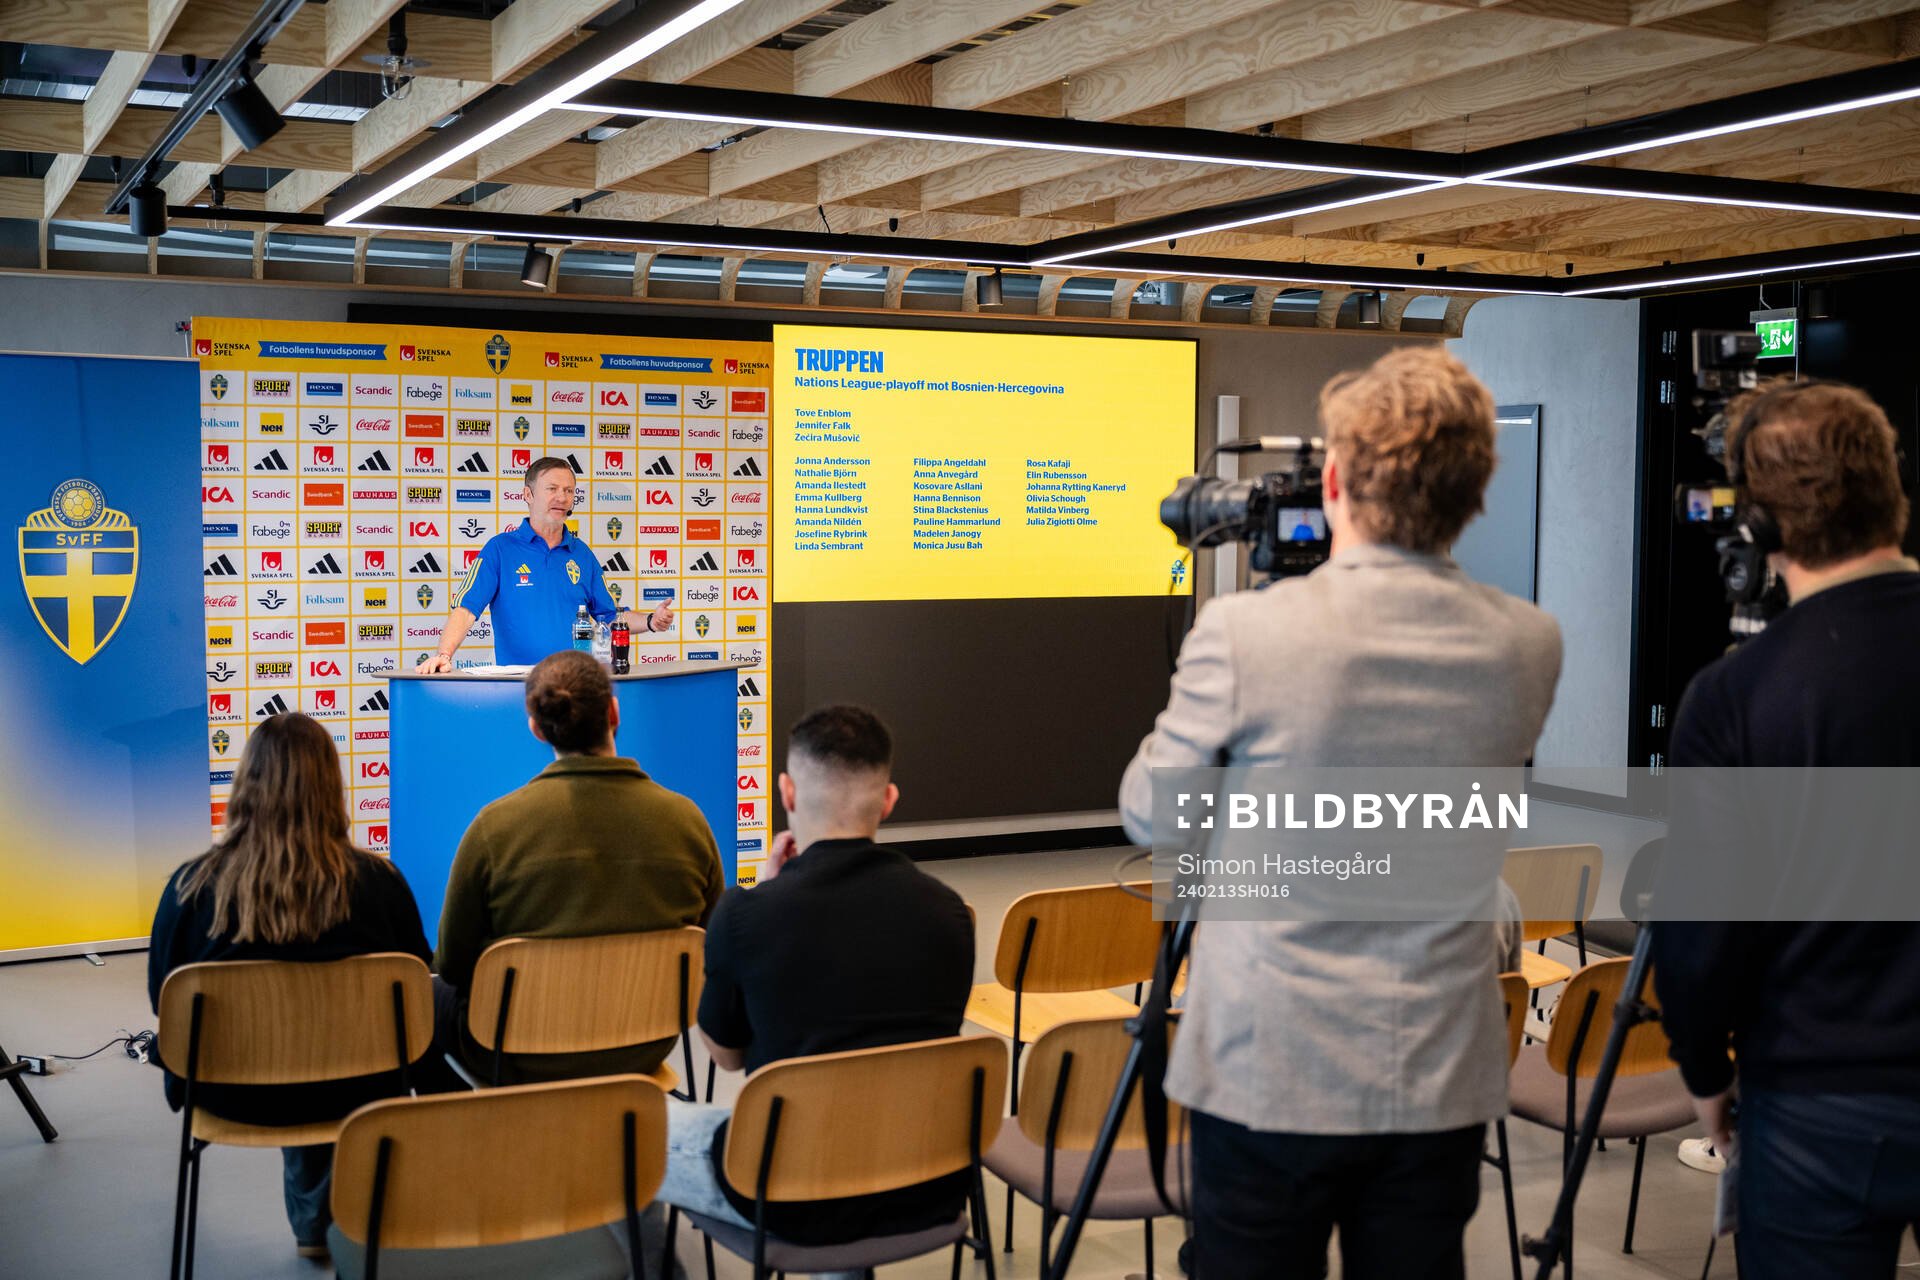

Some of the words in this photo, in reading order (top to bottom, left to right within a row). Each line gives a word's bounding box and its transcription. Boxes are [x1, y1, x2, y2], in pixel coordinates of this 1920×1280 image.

[269, 345, 315, 355] Fotbollens
[315, 347, 376, 357] huvudsponsor
[609, 358, 649, 367] Fotbollens
[650, 360, 704, 369] huvudsponsor
[795, 349, 883, 373] TRUPPEN
[254, 380, 290, 392] SPORT
[355, 386, 392, 395] Scandic
[794, 376, 839, 388] Nations
[841, 377, 926, 392] League-playoff
[927, 381, 950, 391] mot
[951, 381, 1065, 396] Bosnien-Hercegovina
[406, 387, 442, 400] Fabege
[456, 388, 492, 398] Folksam
[700, 390, 709, 399] SJ
[601, 391, 629, 406] ICA
[795, 408, 817, 417] Tove
[817, 409, 852, 418] Enblom
[201, 418, 239, 428] Folksam
[318, 415, 329, 424] SJ
[457, 420, 490, 432] SPORT
[599, 423, 630, 434] SPORT
[795, 421, 832, 430] Jennifer
[832, 421, 851, 430] Falk
[688, 429, 720, 438] Scandic
[732, 430, 763, 443] Fabege
[794, 433, 822, 442] Zećira
[823, 433, 860, 442] Mušović
[795, 456, 822, 465] Jonna
[823, 456, 871, 466] Andersson
[913, 457, 943, 468] Filippa
[943, 458, 987, 468] Angeldahl
[1026, 459, 1047, 468] Rosa
[1047, 459, 1071, 469] Kafaji
[794, 469, 832, 477] Nathalie
[833, 469, 857, 479] Björn
[913, 470, 936, 478] Anna
[937, 470, 979, 480] Anvegård
[1026, 471, 1042, 479] Elin
[1043, 471, 1087, 480] Rubensson
[794, 481, 832, 489] Amanda
[833, 481, 866, 490] Ilestedt
[913, 481, 953, 490] Kosovare
[954, 482, 983, 491] Asllani
[1026, 482, 1061, 491] Johanna
[1062, 482, 1092, 493] Rytting
[1092, 483, 1126, 492] Kaneryd
[202, 486, 234, 503] ICA
[252, 490, 290, 498] Scandic
[353, 491, 397, 499] BAUHAUS
[408, 488, 442, 498] SPORT
[598, 492, 632, 501] Folksam
[646, 490, 674, 505] ICA
[699, 488, 709, 497] SJ
[794, 493, 823, 502] Emma
[824, 493, 863, 503] Kullberg
[913, 494, 941, 502] Hanna
[942, 493, 981, 503] Bennison
[1026, 494, 1050, 503] Olivia
[1050, 494, 1086, 504] Schough
[794, 505, 824, 514] Hanna
[825, 505, 868, 514] Lundkvist
[913, 505, 935, 514] Stina
[936, 505, 989, 514] Blackstenius
[1026, 505, 1057, 514] Matilda
[1057, 506, 1090, 516] Vinberg
[467, 519, 478, 528] SJ
[795, 517, 832, 526] Amanda
[833, 517, 862, 526] Nildén
[913, 517, 945, 526] Pauline
[946, 517, 1001, 526] Hammarlund
[1026, 517, 1046, 526] Julia
[1046, 517, 1076, 527] Zigiotti
[1076, 517, 1098, 526] Olme
[252, 526, 290, 539] Fabege
[307, 522, 342, 533] SPORT
[356, 525, 393, 534] Scandic
[410, 522, 439, 537] ICA
[731, 525, 762, 538] Fabege
[794, 529, 832, 538] Josefine
[833, 529, 868, 539] Rybrink
[913, 529, 950, 538] Madelen
[951, 529, 982, 539] Janogy
[56, 533, 103, 546] SvFF
[794, 542, 820, 551] Linda
[820, 542, 864, 550] Sembrant
[913, 541, 945, 550] Monica
[945, 541, 966, 550] Jusu
[966, 541, 983, 550] Bah
[267, 590, 277, 599] SJ
[688, 588, 719, 602] Fabege
[733, 586, 759, 600] ICA
[306, 595, 344, 604] Folksam
[253, 630, 294, 640] Scandic
[359, 625, 392, 636] SPORT
[407, 627, 442, 637] Scandic
[216, 662, 227, 671] SJ
[256, 662, 292, 674] SPORT
[310, 661, 341, 677] ICA
